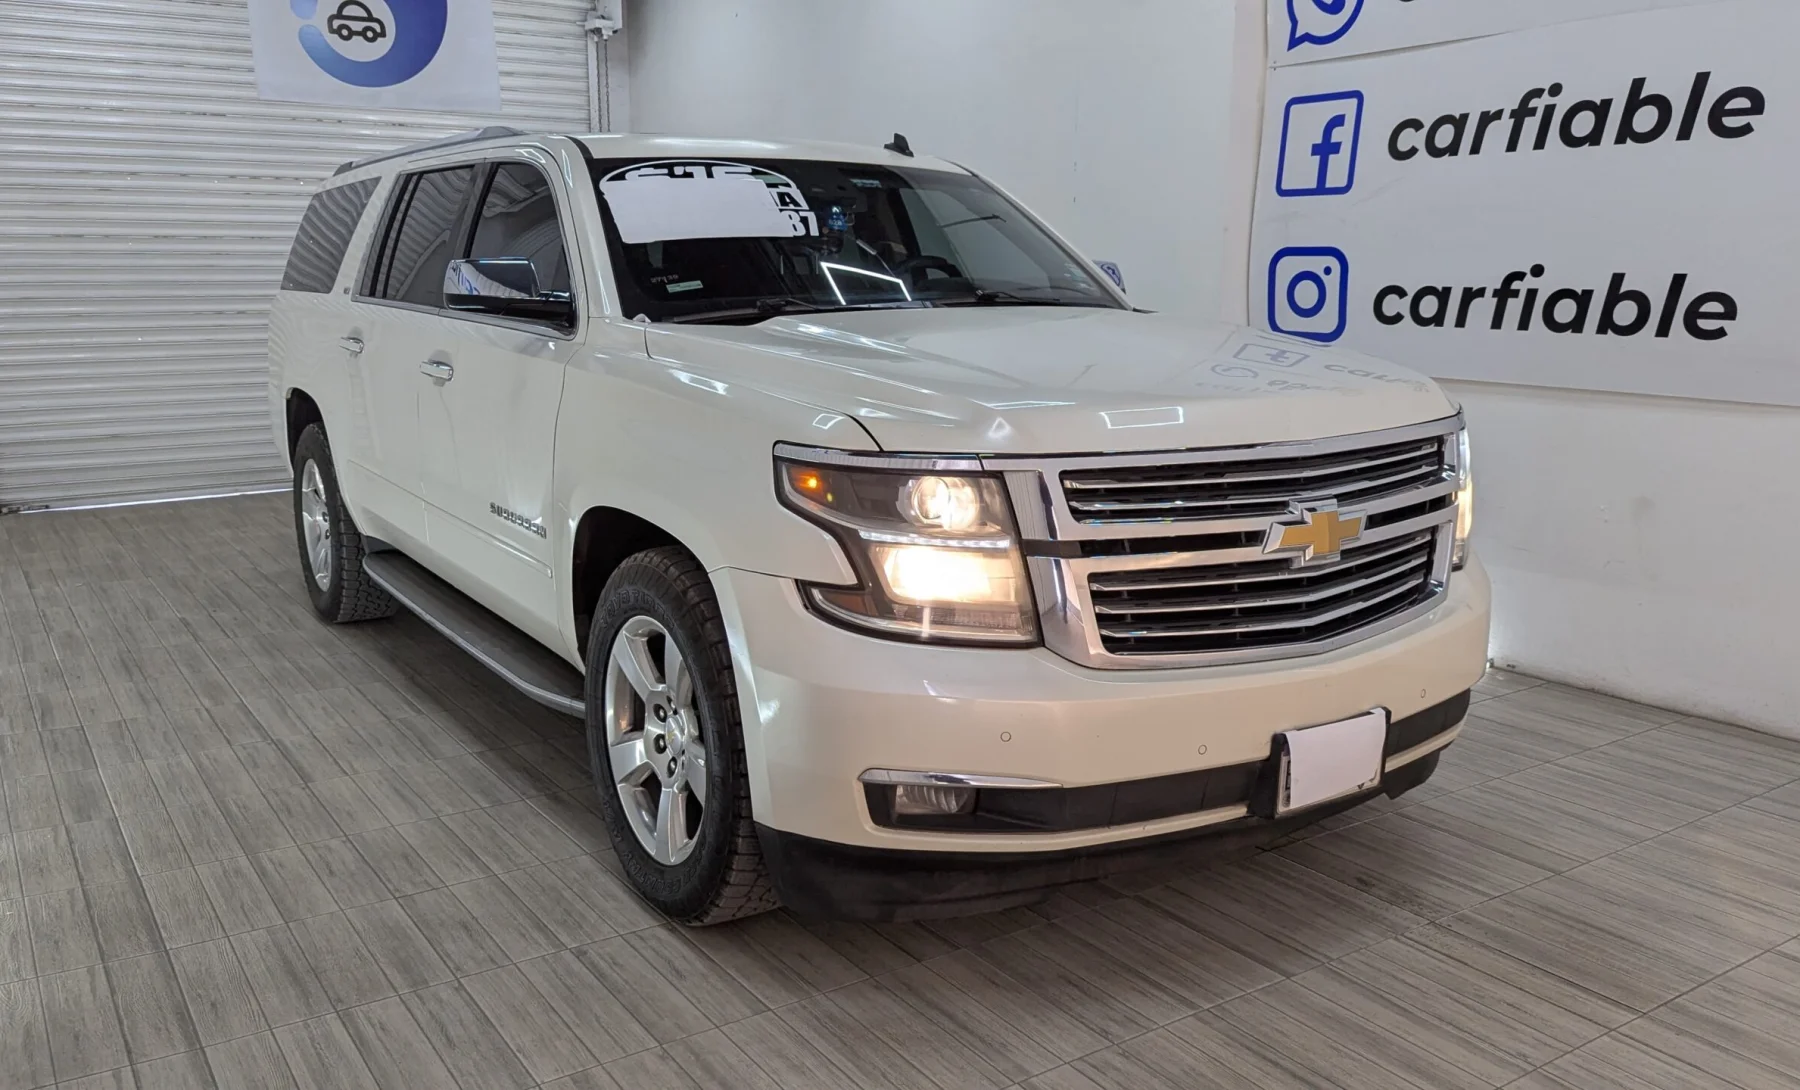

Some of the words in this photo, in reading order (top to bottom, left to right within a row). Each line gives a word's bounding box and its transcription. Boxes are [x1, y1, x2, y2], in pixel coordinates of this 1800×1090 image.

[1387, 71, 1766, 161] carfiable
[1372, 263, 1738, 341] carfiable
[489, 501, 547, 540] SUBURBAN
